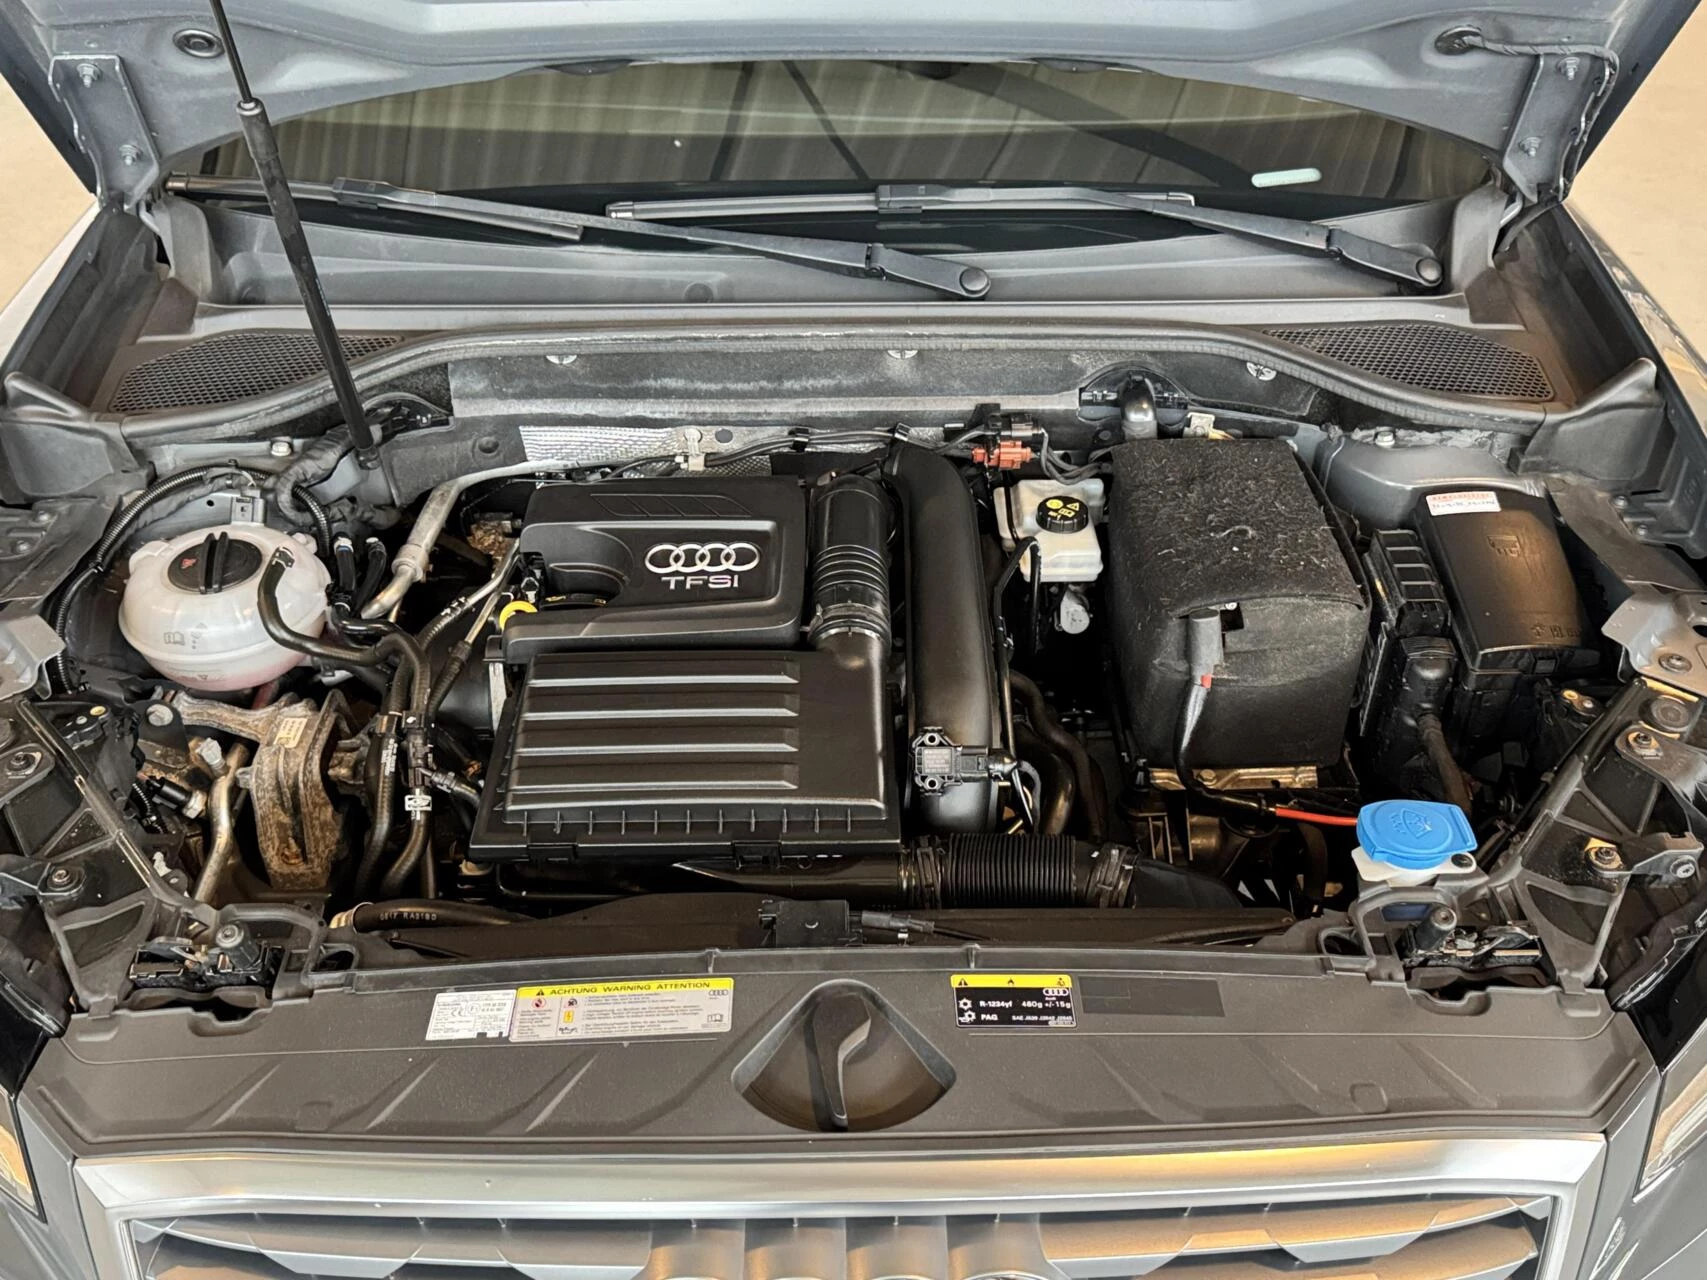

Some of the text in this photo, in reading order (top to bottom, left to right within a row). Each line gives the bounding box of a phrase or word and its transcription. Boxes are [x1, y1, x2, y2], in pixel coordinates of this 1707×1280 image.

[661, 574, 739, 590] TFSI
[550, 982, 711, 995] ACHTUNG WARNING ATTENTION
[979, 1000, 1013, 1008] R-1234yf
